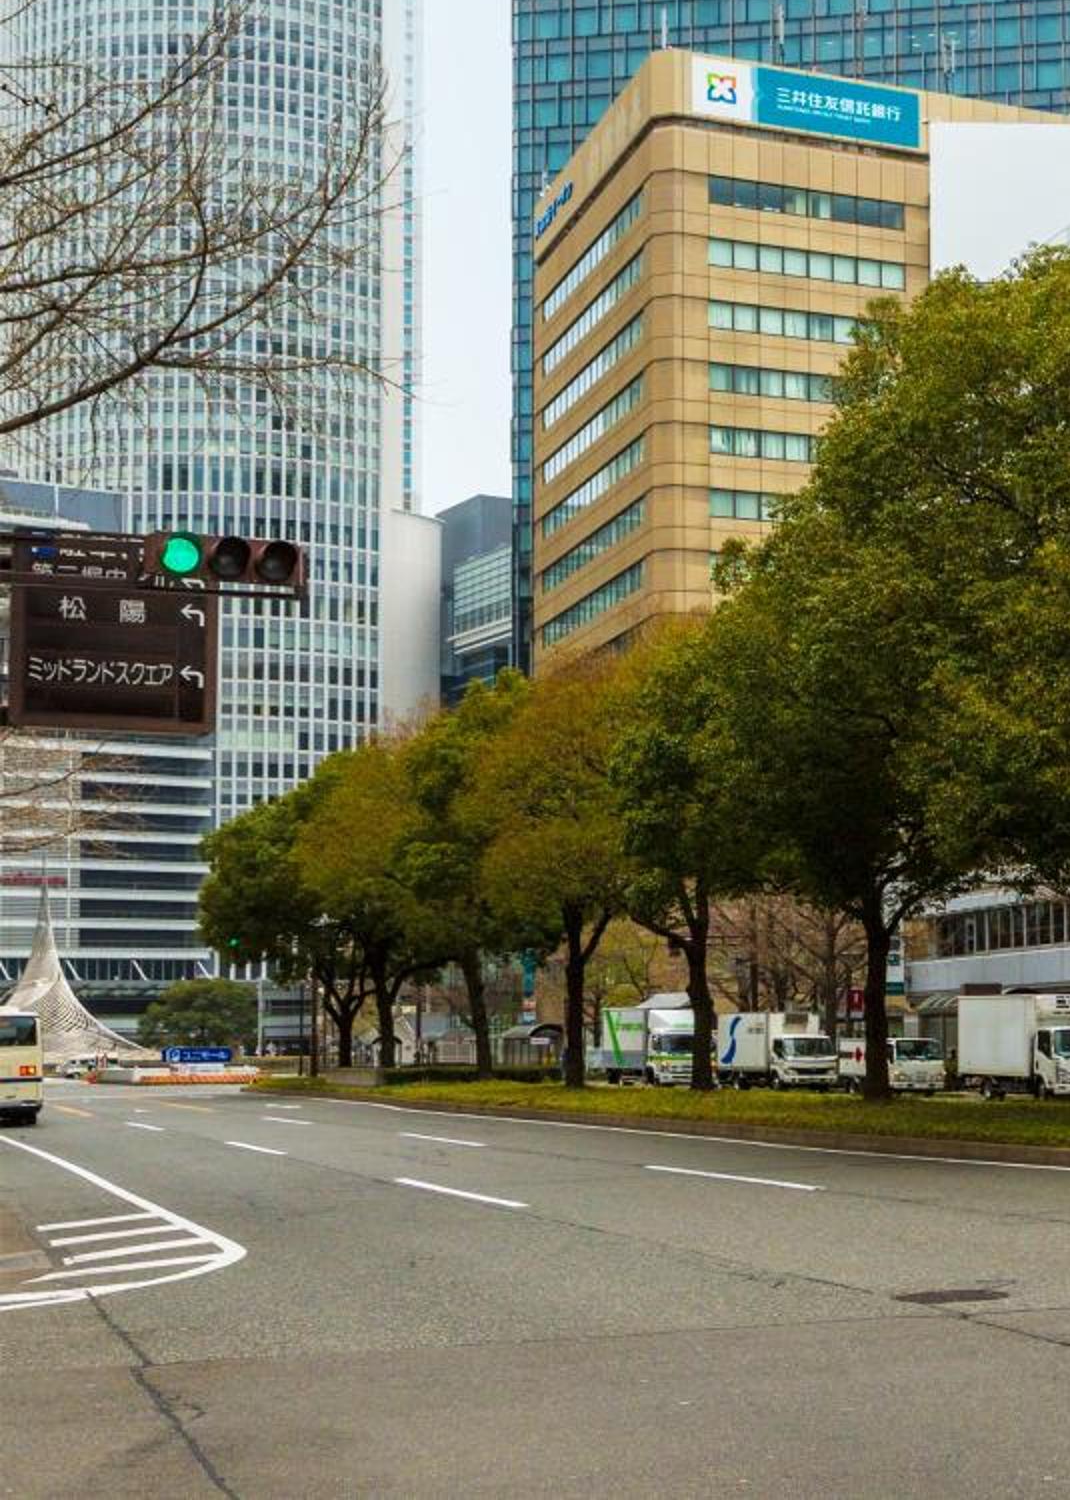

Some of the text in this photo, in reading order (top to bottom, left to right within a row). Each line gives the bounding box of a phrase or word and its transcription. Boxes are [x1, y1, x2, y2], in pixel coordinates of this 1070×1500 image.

[776, 87, 902, 122] 三井住友信託銀行
[28, 656, 173, 686] ミッドランドスクエア
